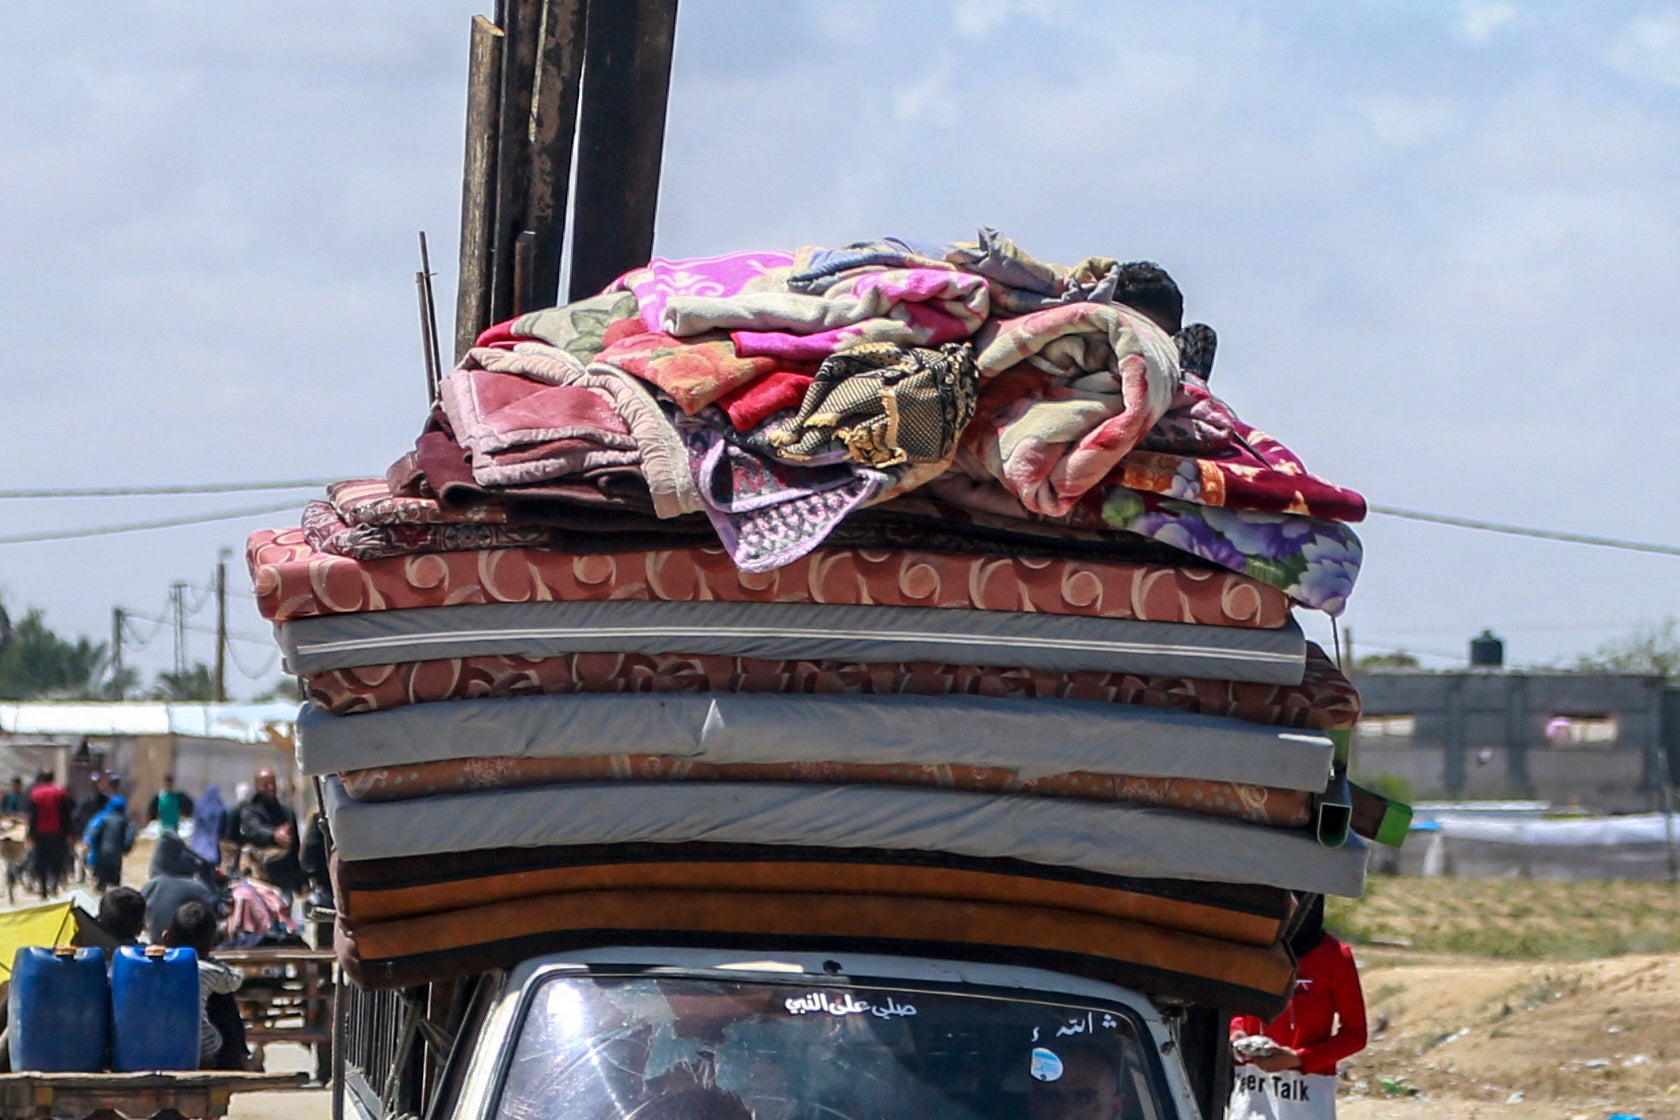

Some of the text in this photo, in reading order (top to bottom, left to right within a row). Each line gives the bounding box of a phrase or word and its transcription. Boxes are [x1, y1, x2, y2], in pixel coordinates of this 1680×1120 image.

[784, 992, 828, 1014] النبي
[871, 997, 917, 1019] صلي
[1272, 1076, 1309, 1102] Talk
